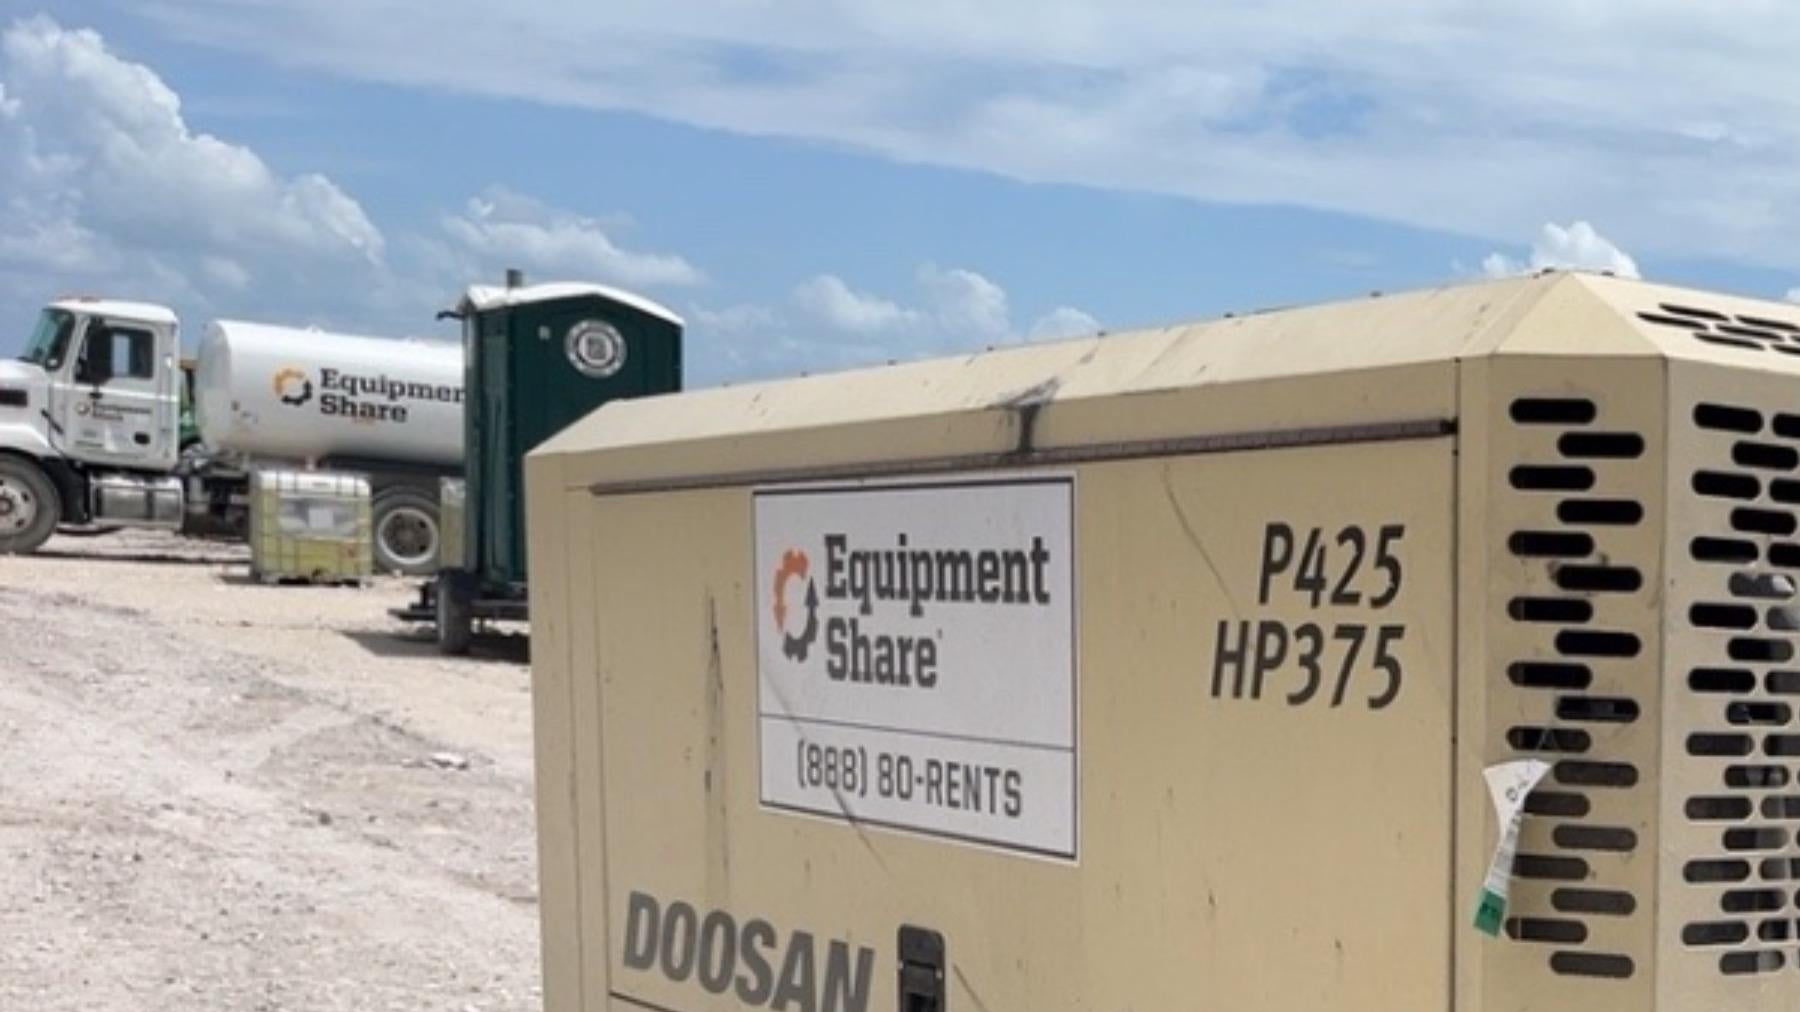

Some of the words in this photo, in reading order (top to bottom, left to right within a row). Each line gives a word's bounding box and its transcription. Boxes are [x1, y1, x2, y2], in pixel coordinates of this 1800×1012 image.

[319, 393, 408, 423] Share
[823, 533, 1051, 617] Equipment
[1258, 521, 1406, 610] P425
[826, 616, 939, 689] Share
[1210, 619, 1406, 710] HP375
[798, 738, 868, 799] (888)
[876, 752, 1023, 818] 80-RENTS
